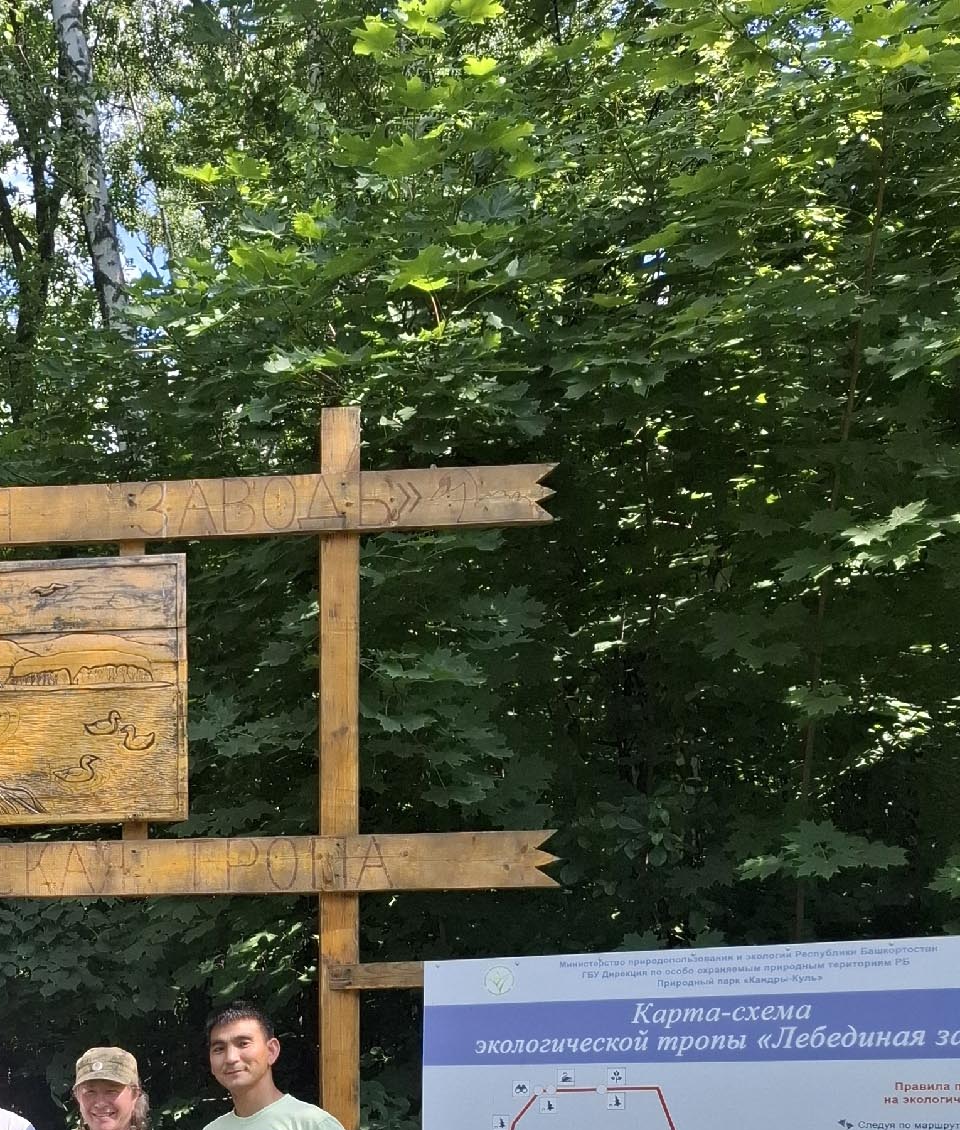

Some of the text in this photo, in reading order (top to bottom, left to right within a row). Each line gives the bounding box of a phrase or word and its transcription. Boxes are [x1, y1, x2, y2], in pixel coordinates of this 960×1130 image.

[795, 948, 857, 960] Республики
[581, 970, 600, 979] ГБУ
[894, 957, 910, 966] РБ
[657, 978, 714, 989] Природный
[631, 1002, 813, 1029] Карта-схема
[474, 1030, 649, 1055] экологической
[656, 1031, 747, 1056] тропы
[756, 1025, 926, 1051] «Лебединая
[894, 1081, 950, 1093] Правила
[884, 1096, 899, 1104] на
[857, 1120, 896, 1130] Следуя
